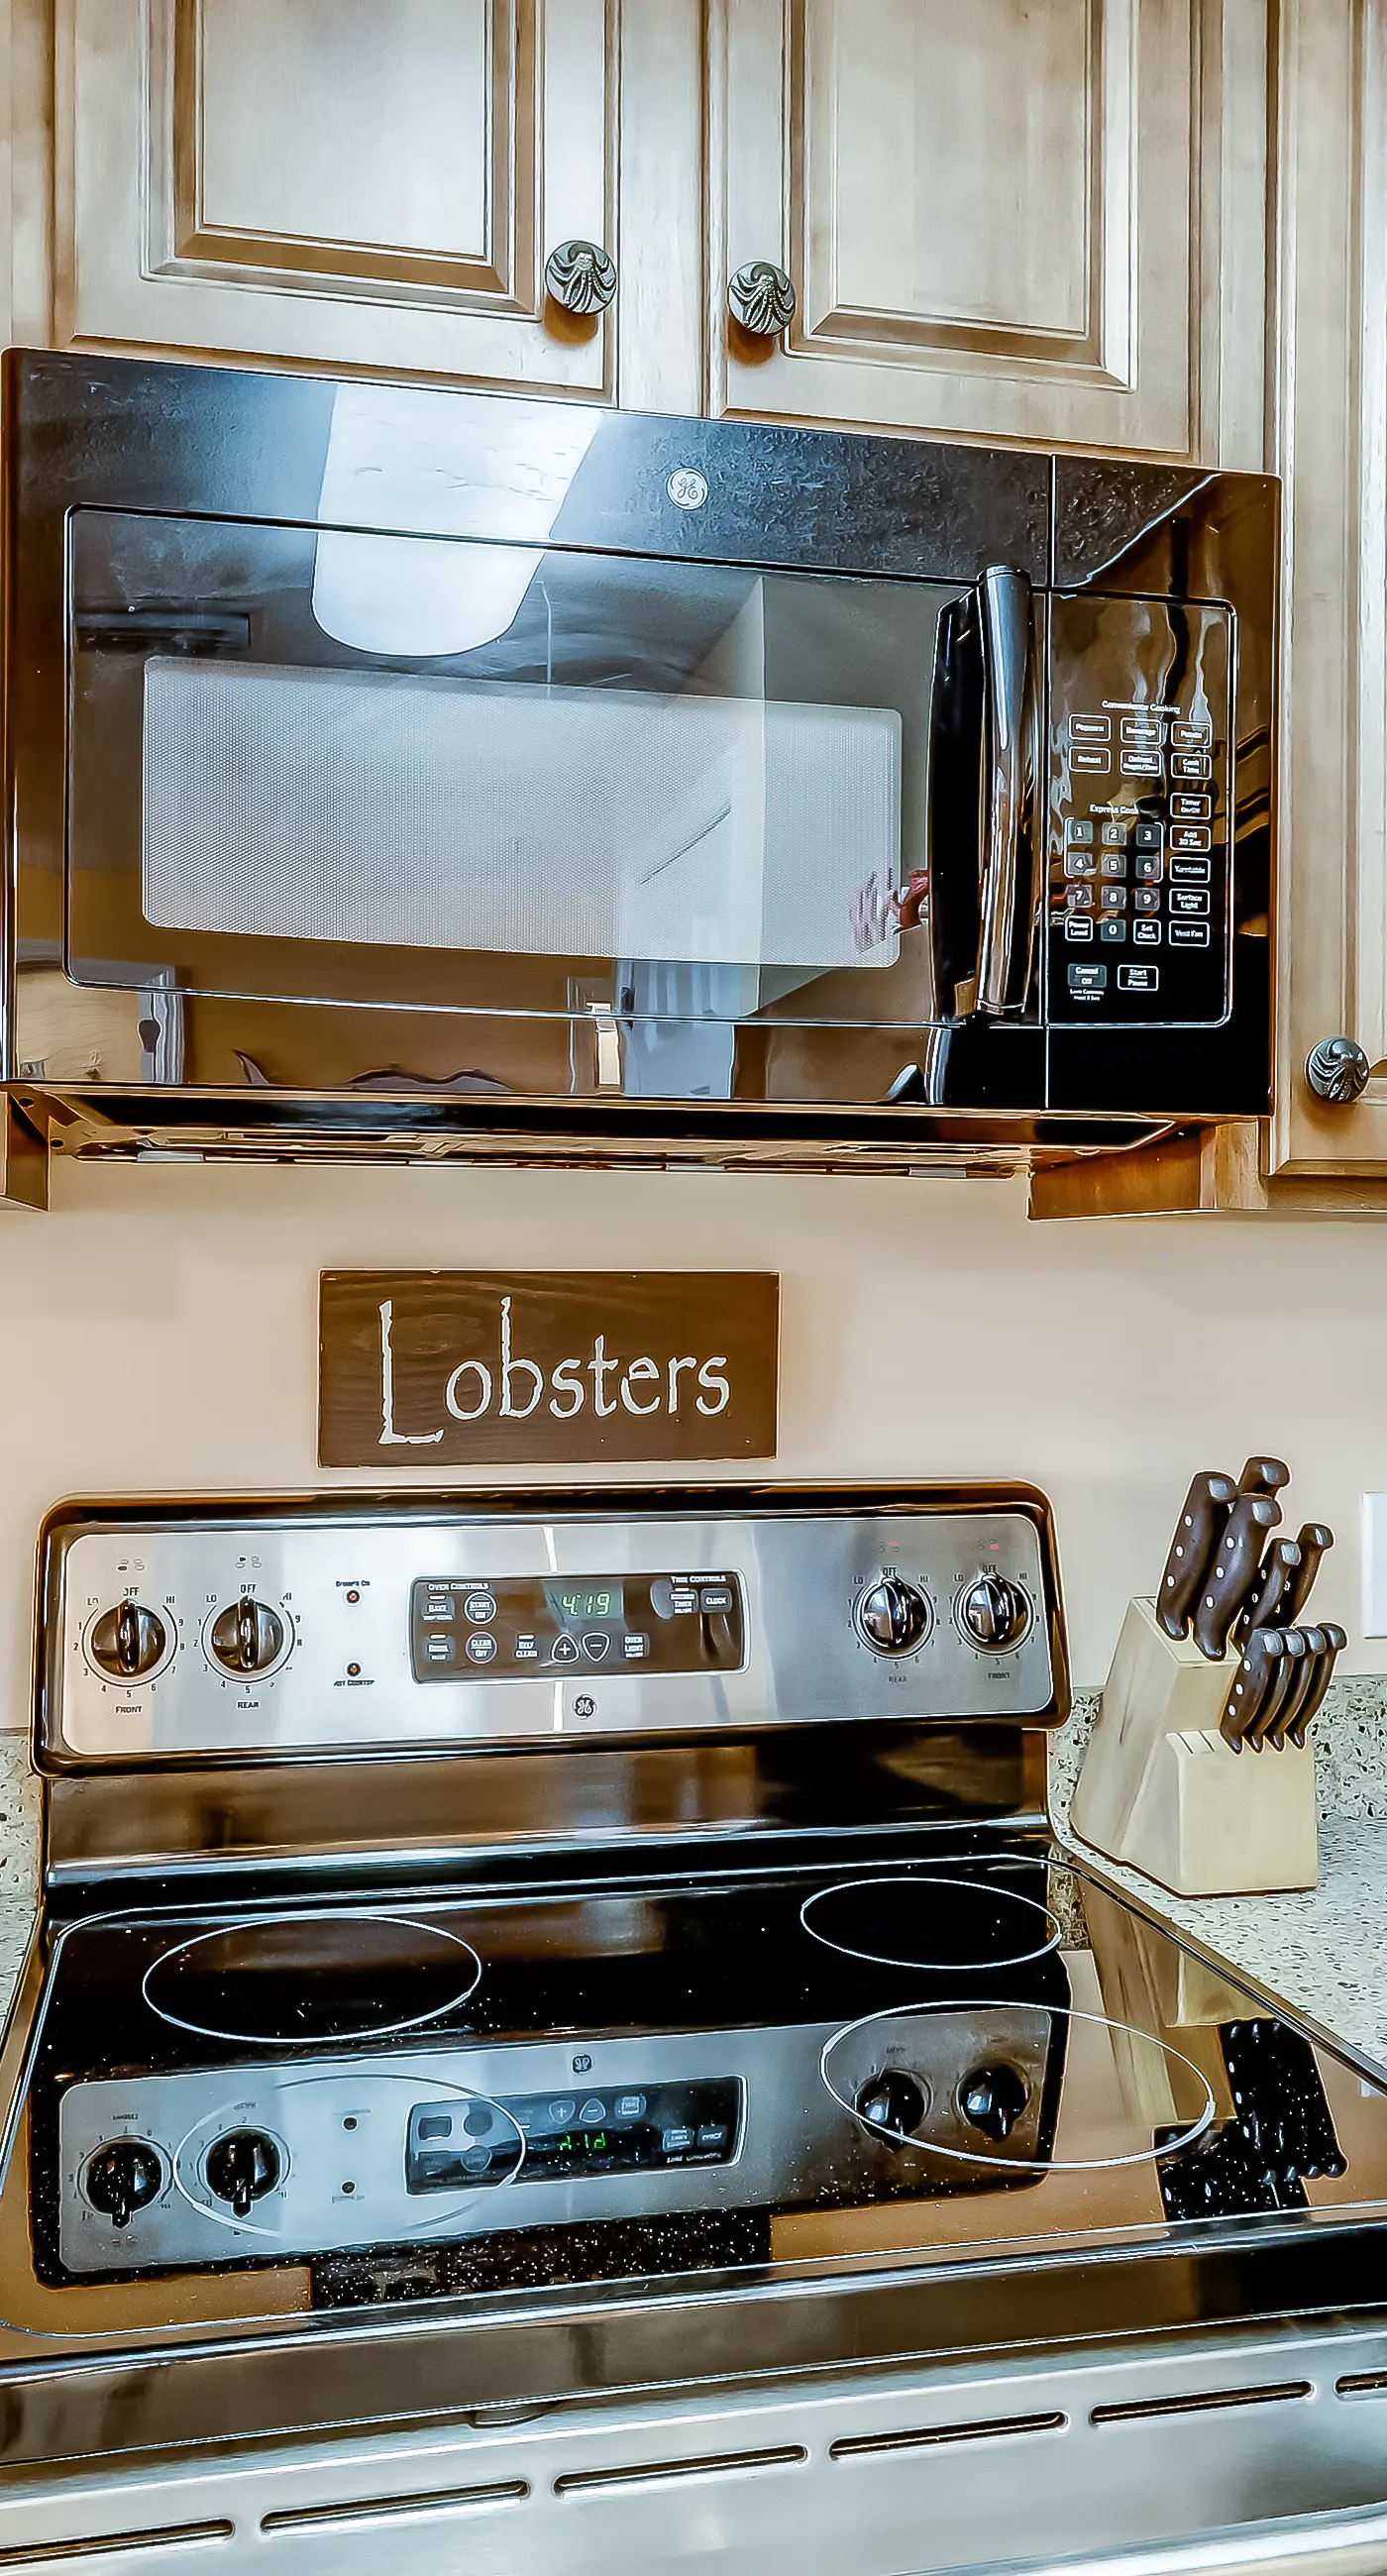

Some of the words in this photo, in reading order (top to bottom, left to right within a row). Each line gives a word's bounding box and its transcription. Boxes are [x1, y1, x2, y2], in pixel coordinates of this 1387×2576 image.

[1075, 826, 1083, 837] 1
[1110, 828, 1119, 839] 2
[1144, 831, 1152, 841] 3
[1075, 858, 1084, 869] 4
[1110, 860, 1118, 871] 5
[1143, 862, 1152, 873] 6
[1075, 890, 1083, 900] 7
[1109, 892, 1118, 903] 8
[1143, 894, 1151, 904] 9
[1108, 925, 1118, 934] 0
[378, 1297, 730, 1444] Lobsters
[165, 1595, 175, 1604] HI
[206, 1594, 218, 1603] LO
[115, 1705, 143, 1714] FRONT
